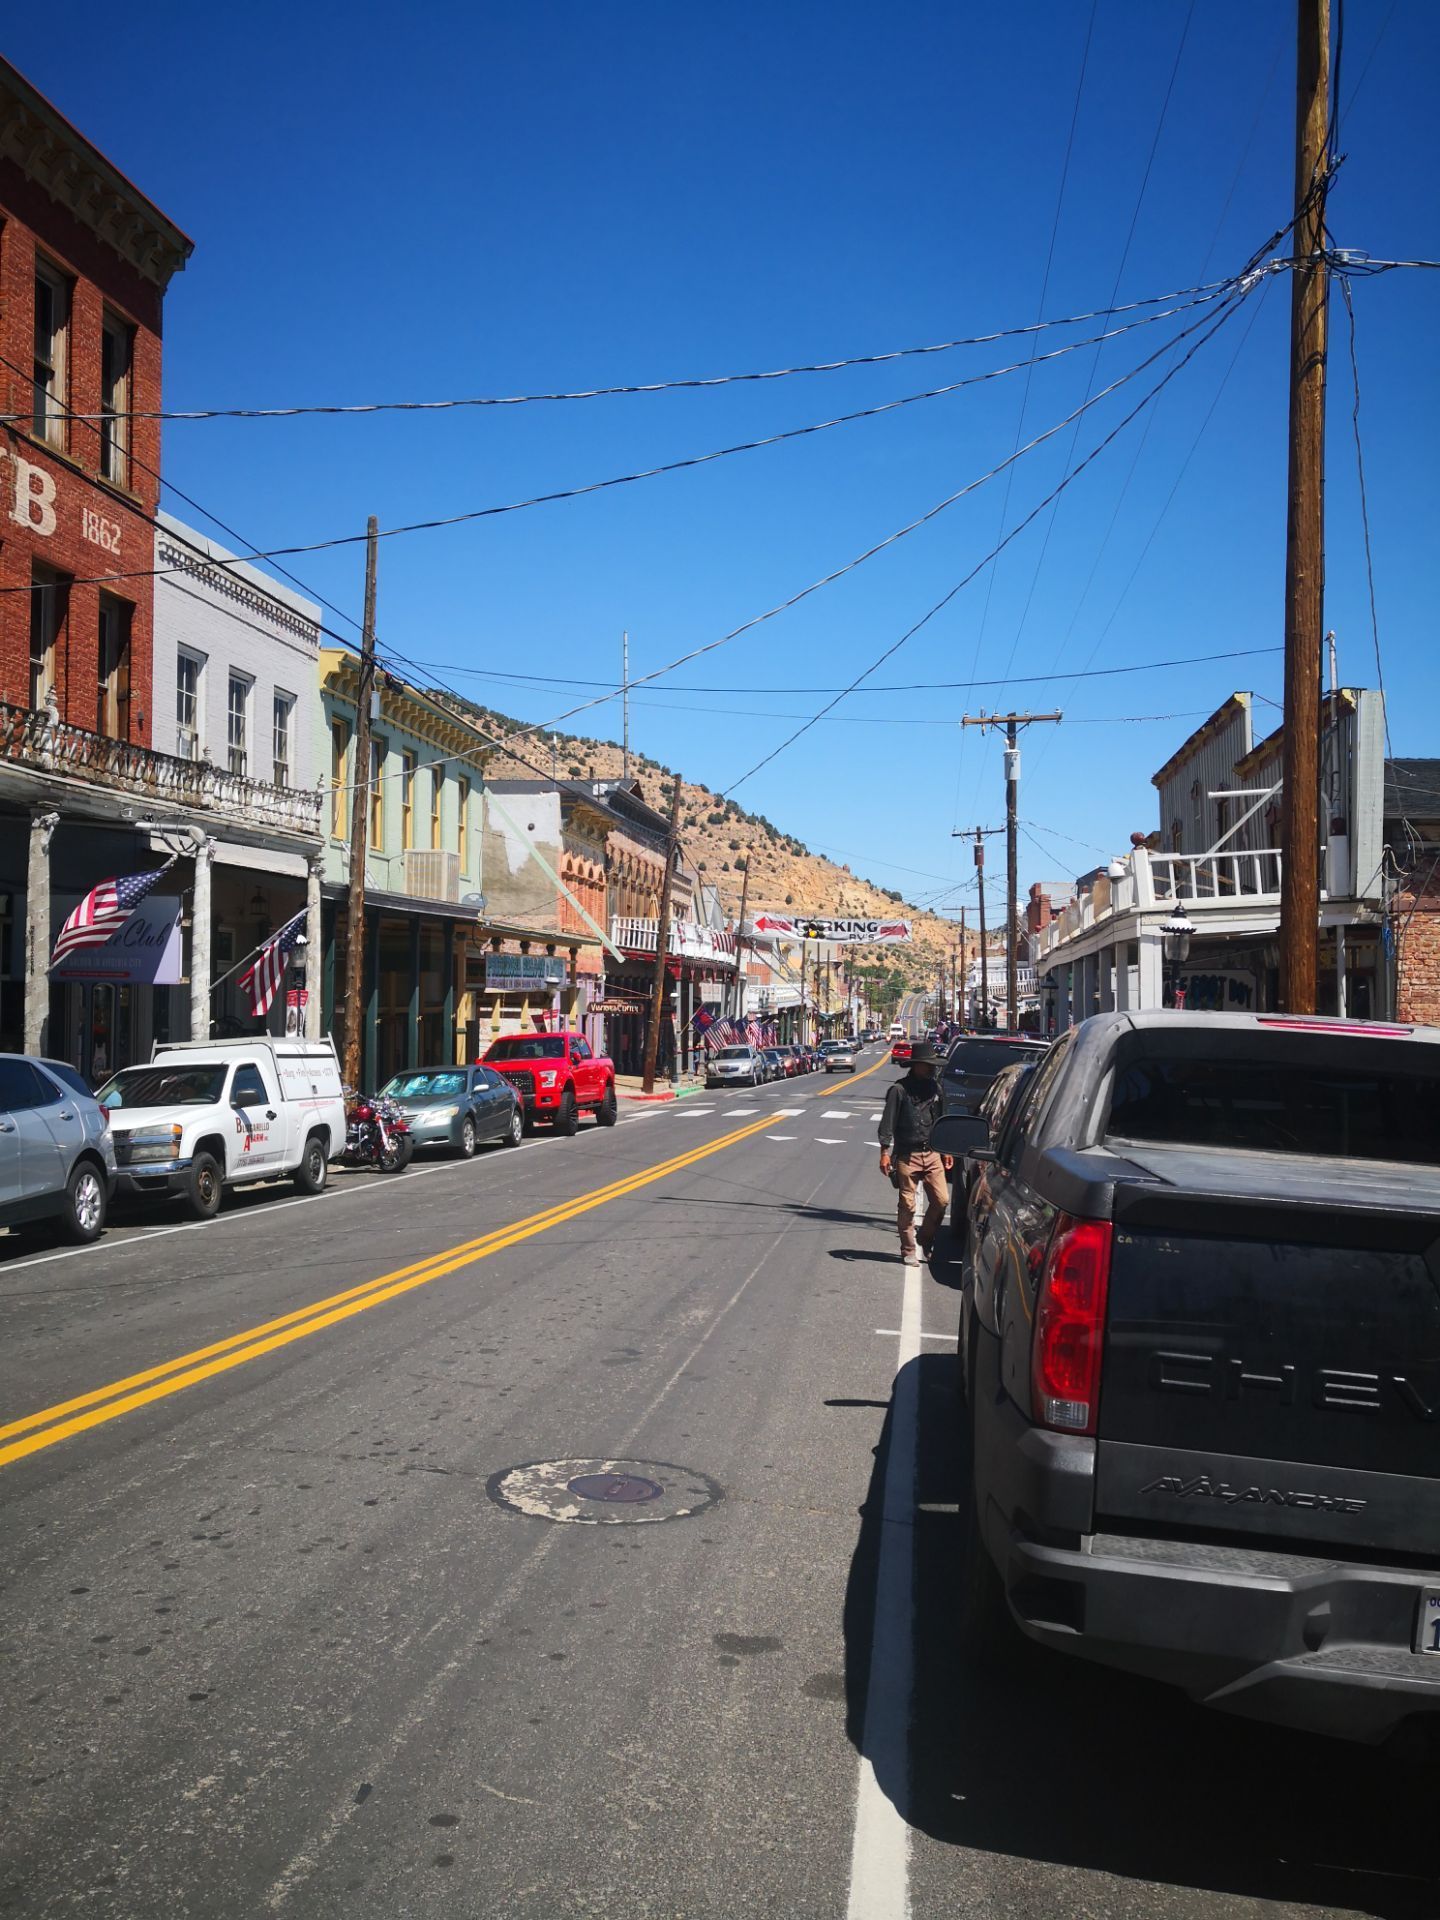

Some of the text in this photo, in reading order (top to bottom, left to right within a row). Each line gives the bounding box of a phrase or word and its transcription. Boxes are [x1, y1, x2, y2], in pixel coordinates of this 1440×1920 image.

[0, 446, 57, 537] B
[82, 507, 121, 556] 1862
[123, 918, 171, 948] Club
[794, 918, 878, 933] PRKING
[1138, 1474, 1367, 1515] AVALANCHE
